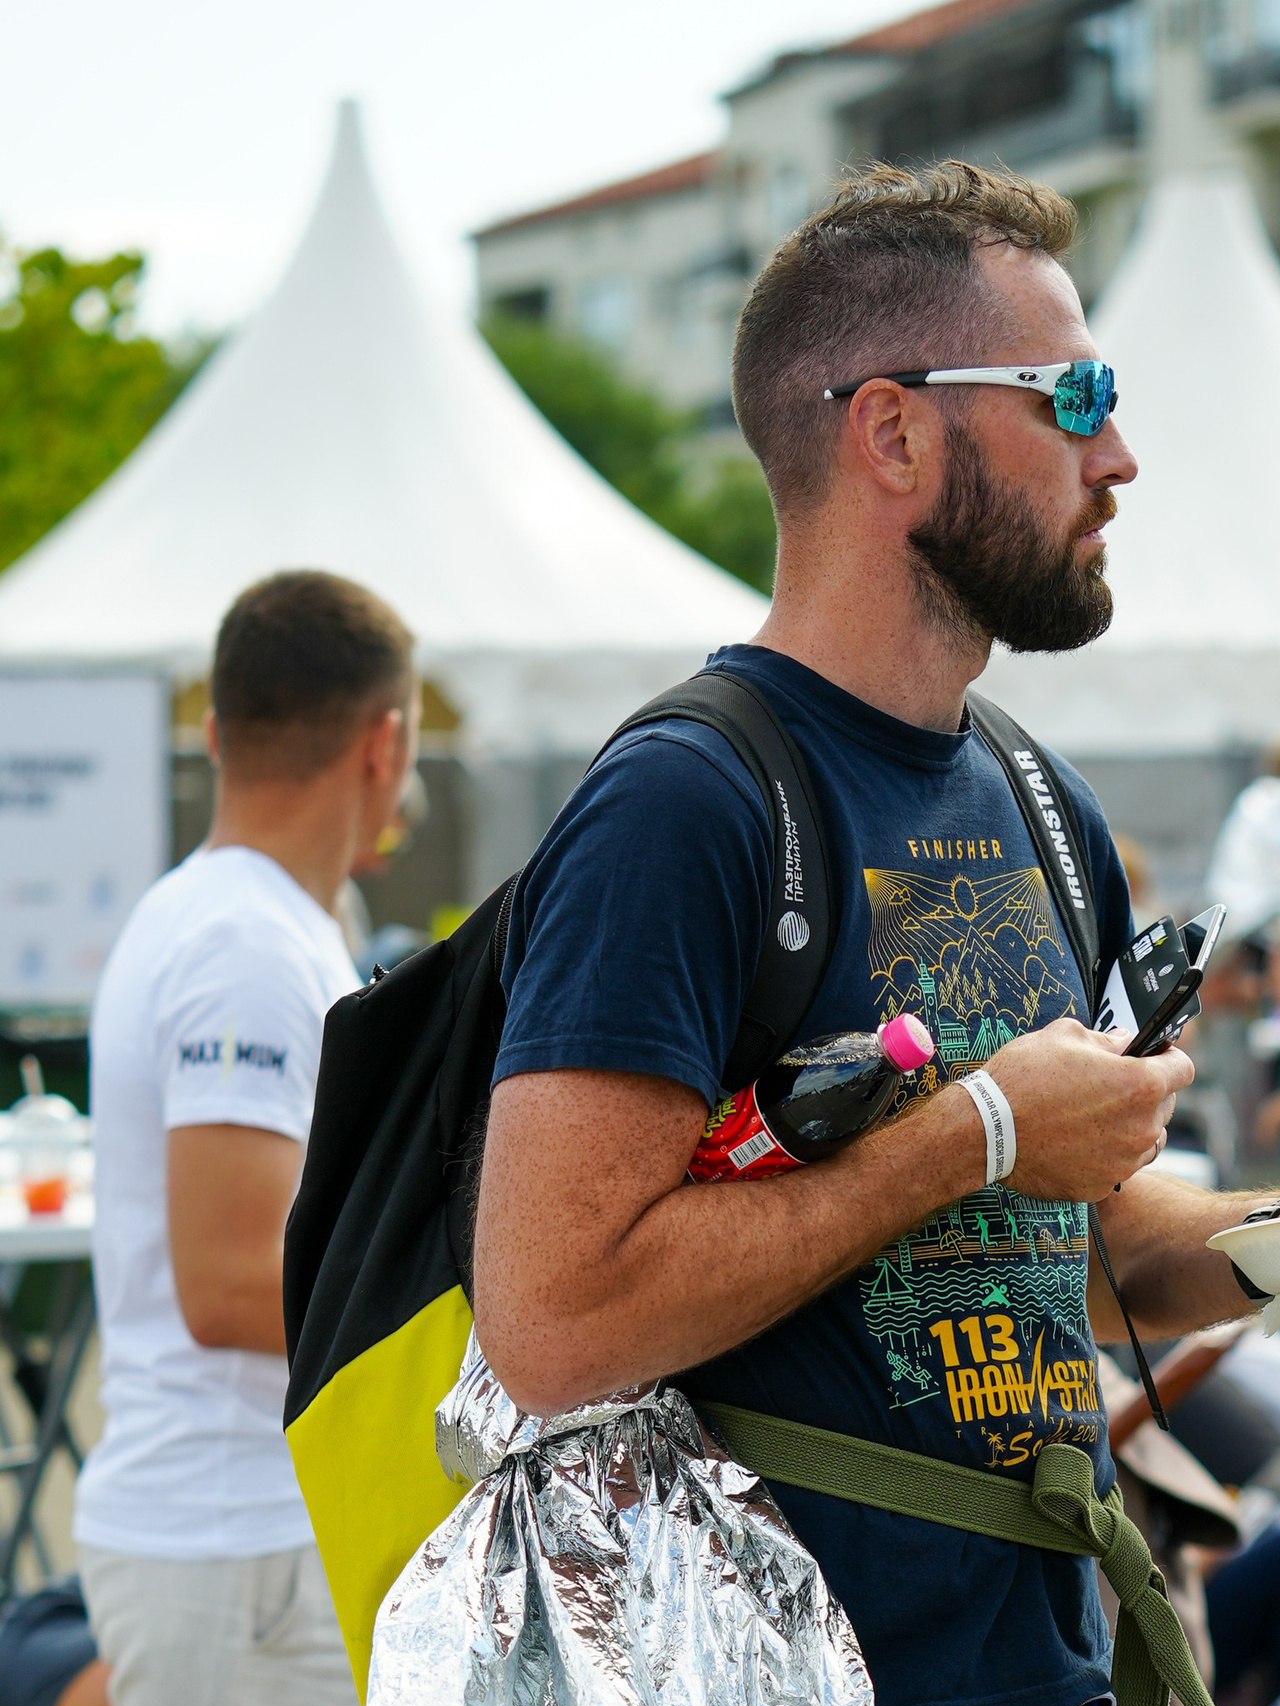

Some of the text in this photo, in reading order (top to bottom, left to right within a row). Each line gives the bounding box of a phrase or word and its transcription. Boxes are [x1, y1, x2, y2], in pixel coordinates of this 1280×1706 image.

[775, 779, 794, 901] ГАЗПРОМБАНК
[907, 839, 1003, 860] FINISHER
[1014, 750, 1086, 909] IRONSTAR
[791, 820, 804, 903] ПРЕМИУМ
[974, 1082, 996, 1111] IRONSTAR
[990, 1109, 1004, 1140] OLYMPIC
[995, 1138, 1004, 1157] SOCHI
[929, 1313, 1020, 1367] 113
[1003, 1416, 1072, 1467] Sohi
